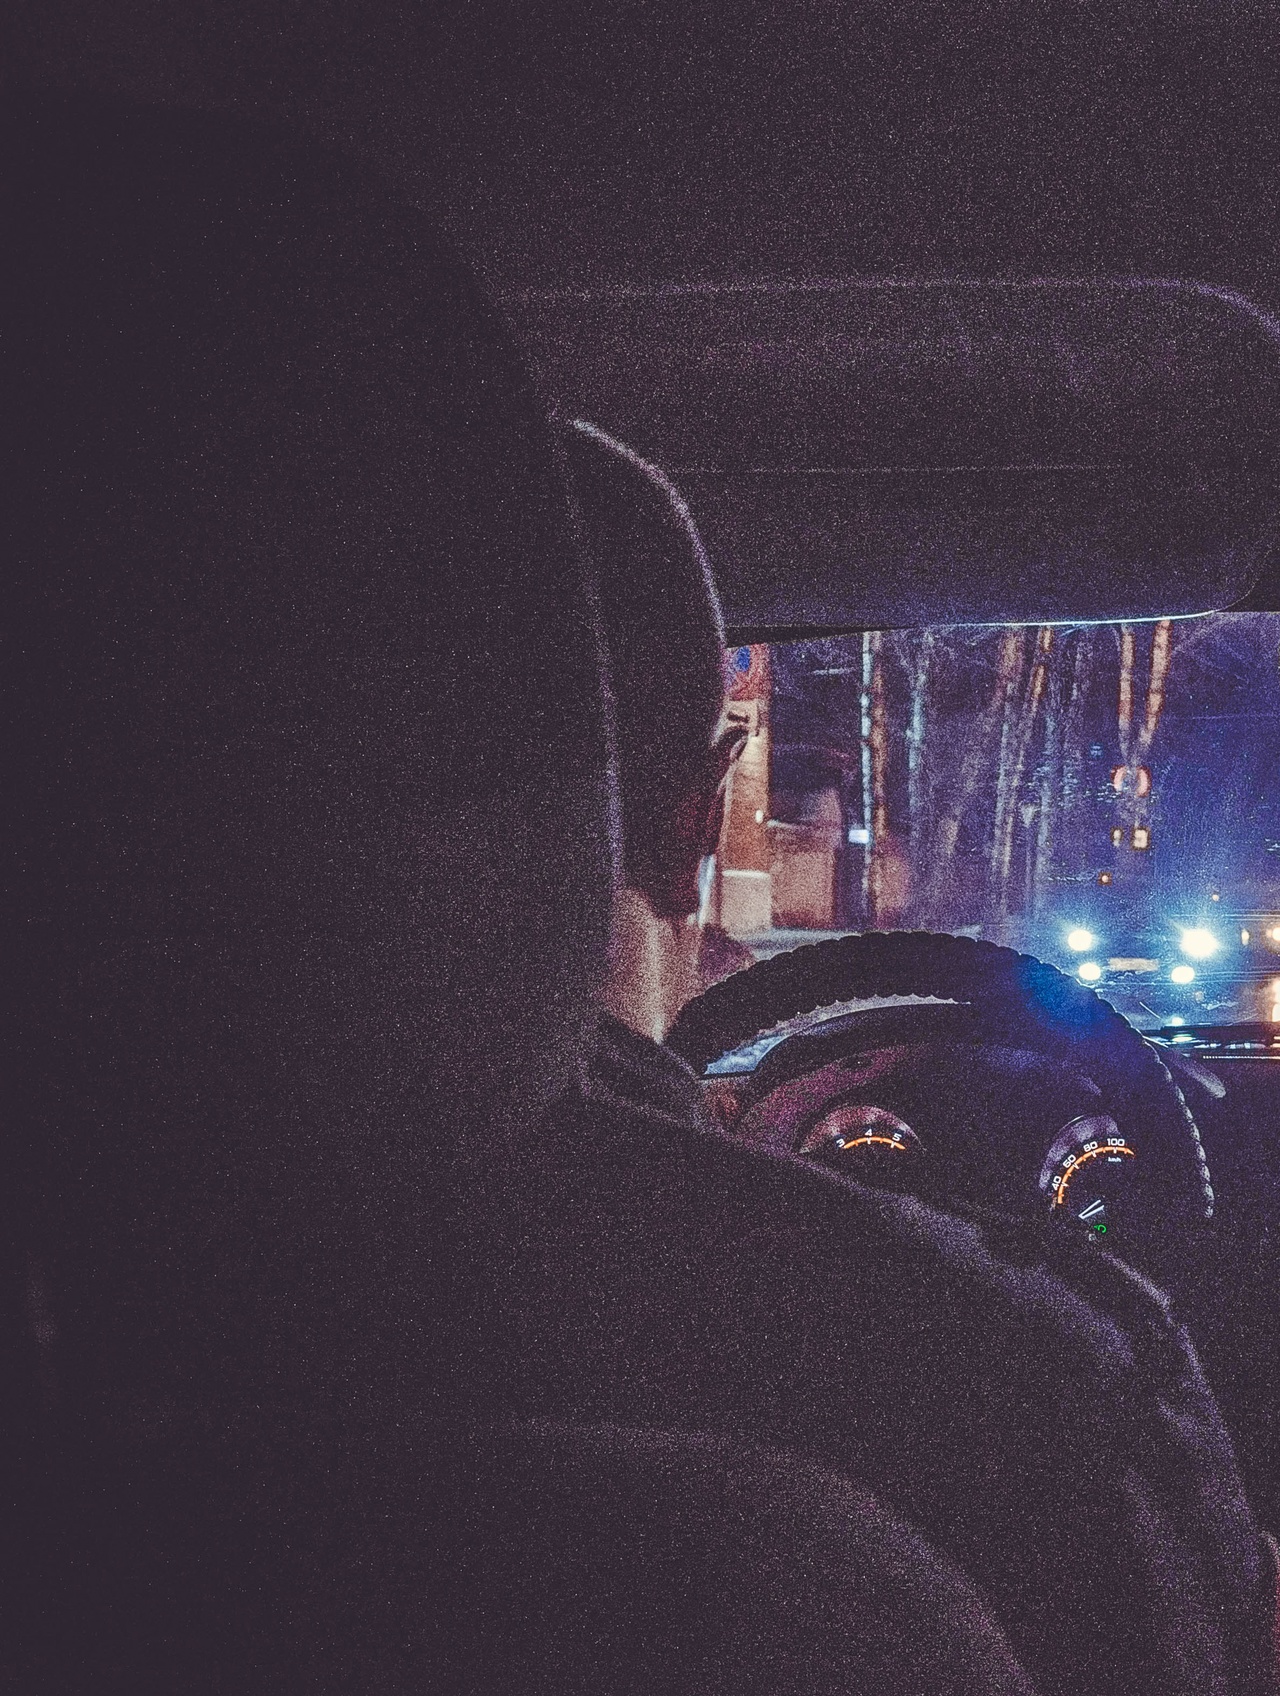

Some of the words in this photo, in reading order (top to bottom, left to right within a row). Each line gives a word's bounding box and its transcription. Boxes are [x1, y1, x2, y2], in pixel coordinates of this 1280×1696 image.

[864, 1128, 873, 1137] 4
[892, 1132, 902, 1142] 5
[1052, 1175, 1062, 1191] 40
[1062, 1154, 1077, 1169] 60
[1083, 1141, 1098, 1153] 80
[1107, 1138, 1125, 1146] 100
